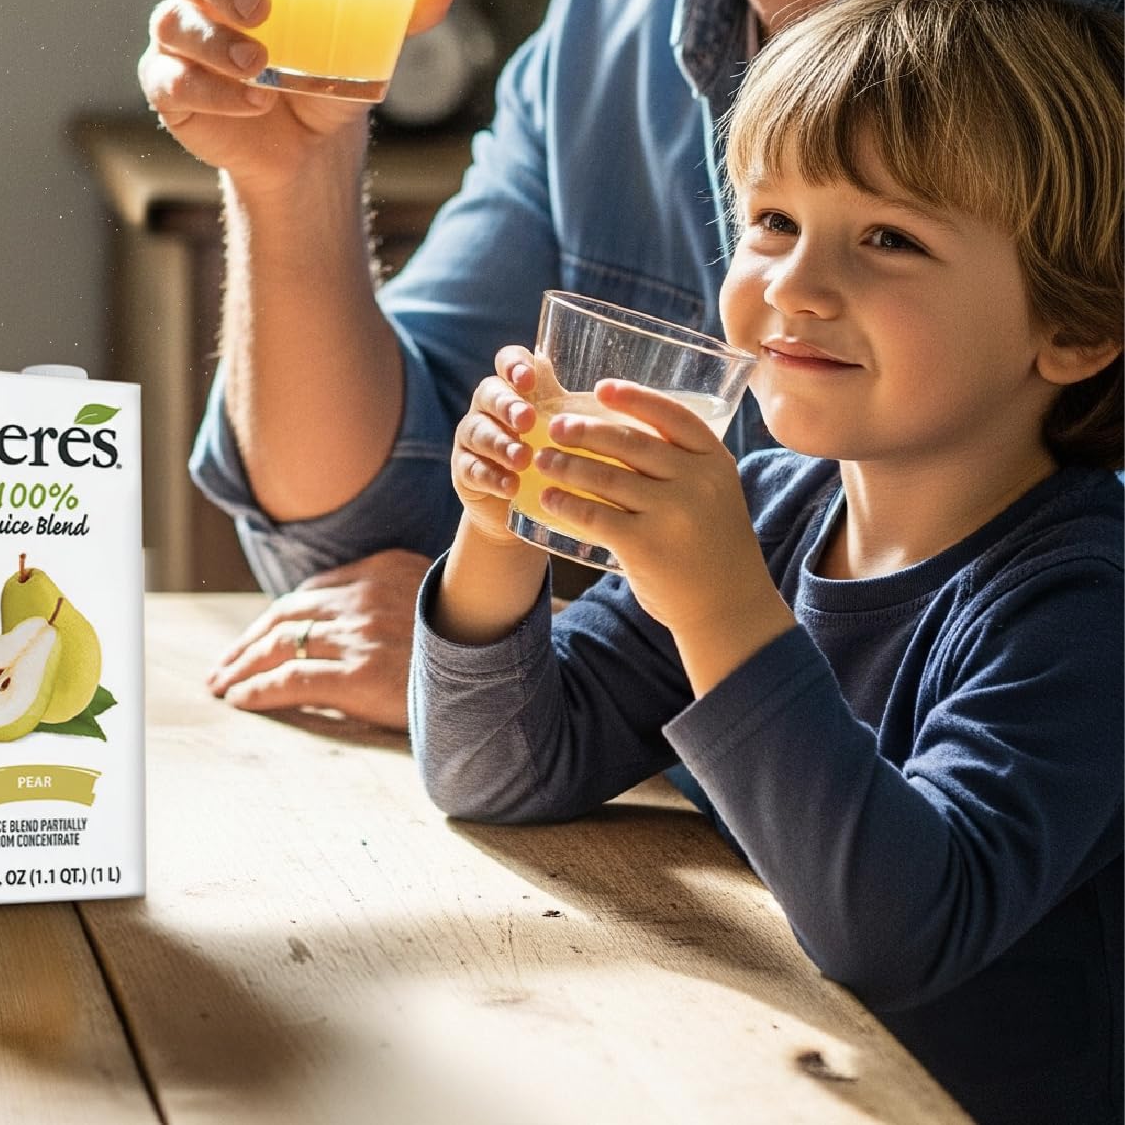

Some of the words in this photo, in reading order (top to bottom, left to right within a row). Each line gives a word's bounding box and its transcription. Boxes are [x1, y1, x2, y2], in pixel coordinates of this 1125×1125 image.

[36, 513, 90, 536] Blend
[17, 776, 52, 789] PEAR
[10, 819, 39, 833] BLEND
[41, 817, 88, 832] PARTIALLY
[17, 832, 80, 848] CONCENTRATE
[5, 869, 26, 885] OZ
[29, 869, 56, 887] (1.1
[60, 867, 87, 885] QT.)
[91, 867, 103, 885] (1
[107, 866, 121, 883] L)
